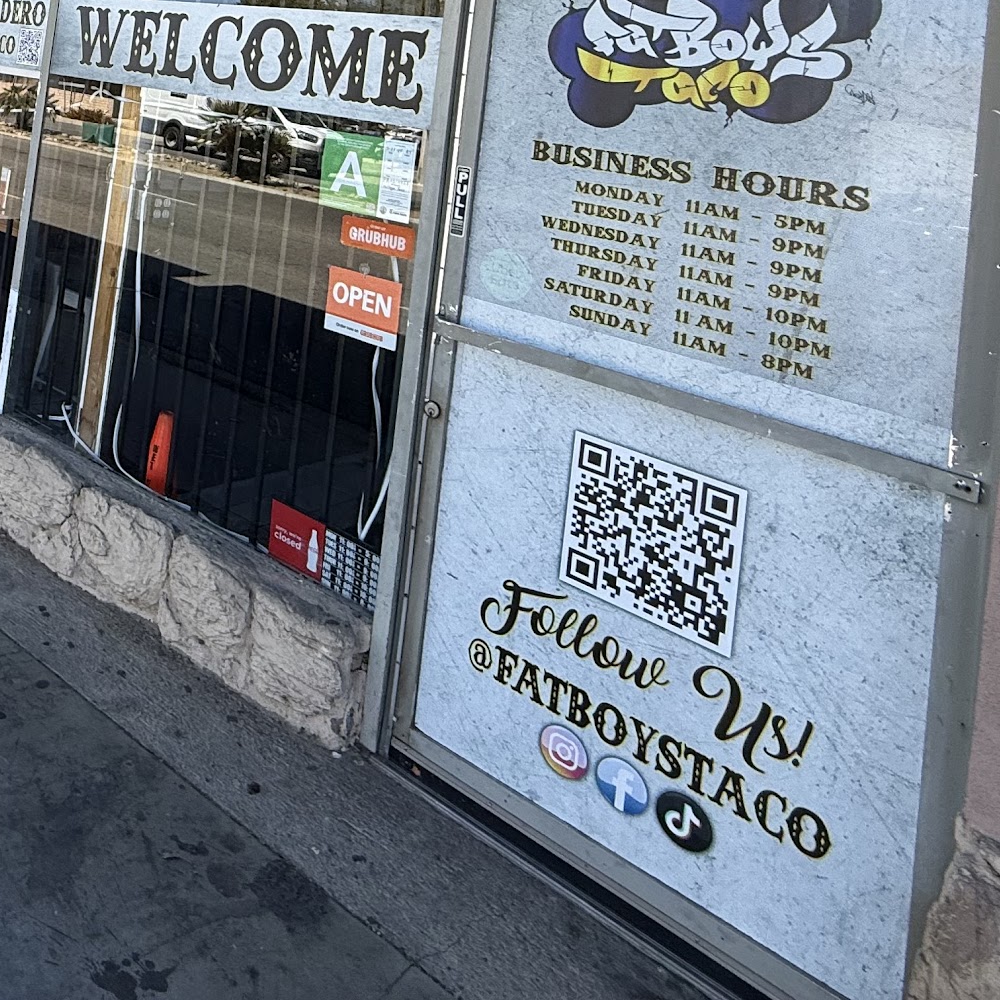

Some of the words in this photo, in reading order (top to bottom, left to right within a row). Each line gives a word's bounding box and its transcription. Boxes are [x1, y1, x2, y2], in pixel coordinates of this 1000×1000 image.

[77, 5, 430, 114] WELCOME
[330, 151, 367, 198] A
[454, 172, 468, 220] PULL
[531, 139, 691, 184] BUSINESS
[711, 166, 871, 212] HOURS
[575, 180, 664, 207] MONDAY
[685, 199, 740, 221] 11AM
[774, 214, 826, 235] 5PM
[349, 226, 406, 251] GRUBHUB
[541, 215, 661, 249] WEDNESDAY
[681, 243, 735, 266] 11AM
[770, 260, 822, 284] 9PM
[572, 200, 663, 228] TUESDAY
[683, 221, 737, 243] 11AM
[772, 237, 824, 259] 9PM
[332, 282, 393, 318] OPEN
[550, 237, 659, 271] THURSDAY
[679, 265, 733, 288] 11AM
[768, 284, 820, 308] 9PM
[577, 264, 656, 293] FRIDAY
[676, 287, 731, 311] 11AM
[765, 307, 828, 333] 10PM
[543, 277, 654, 314] SATURDAY
[768, 332, 832, 359] 10PM
[569, 304, 652, 336] SUNDAY
[673, 331, 726, 357] 11AM
[761, 354, 813, 380] 8PM
[274, 531, 302, 550] closed
[480, 579, 670, 688] Follow
[693, 665, 814, 774] Us!
[469, 638, 831, 860] @FATBOYSTACO
